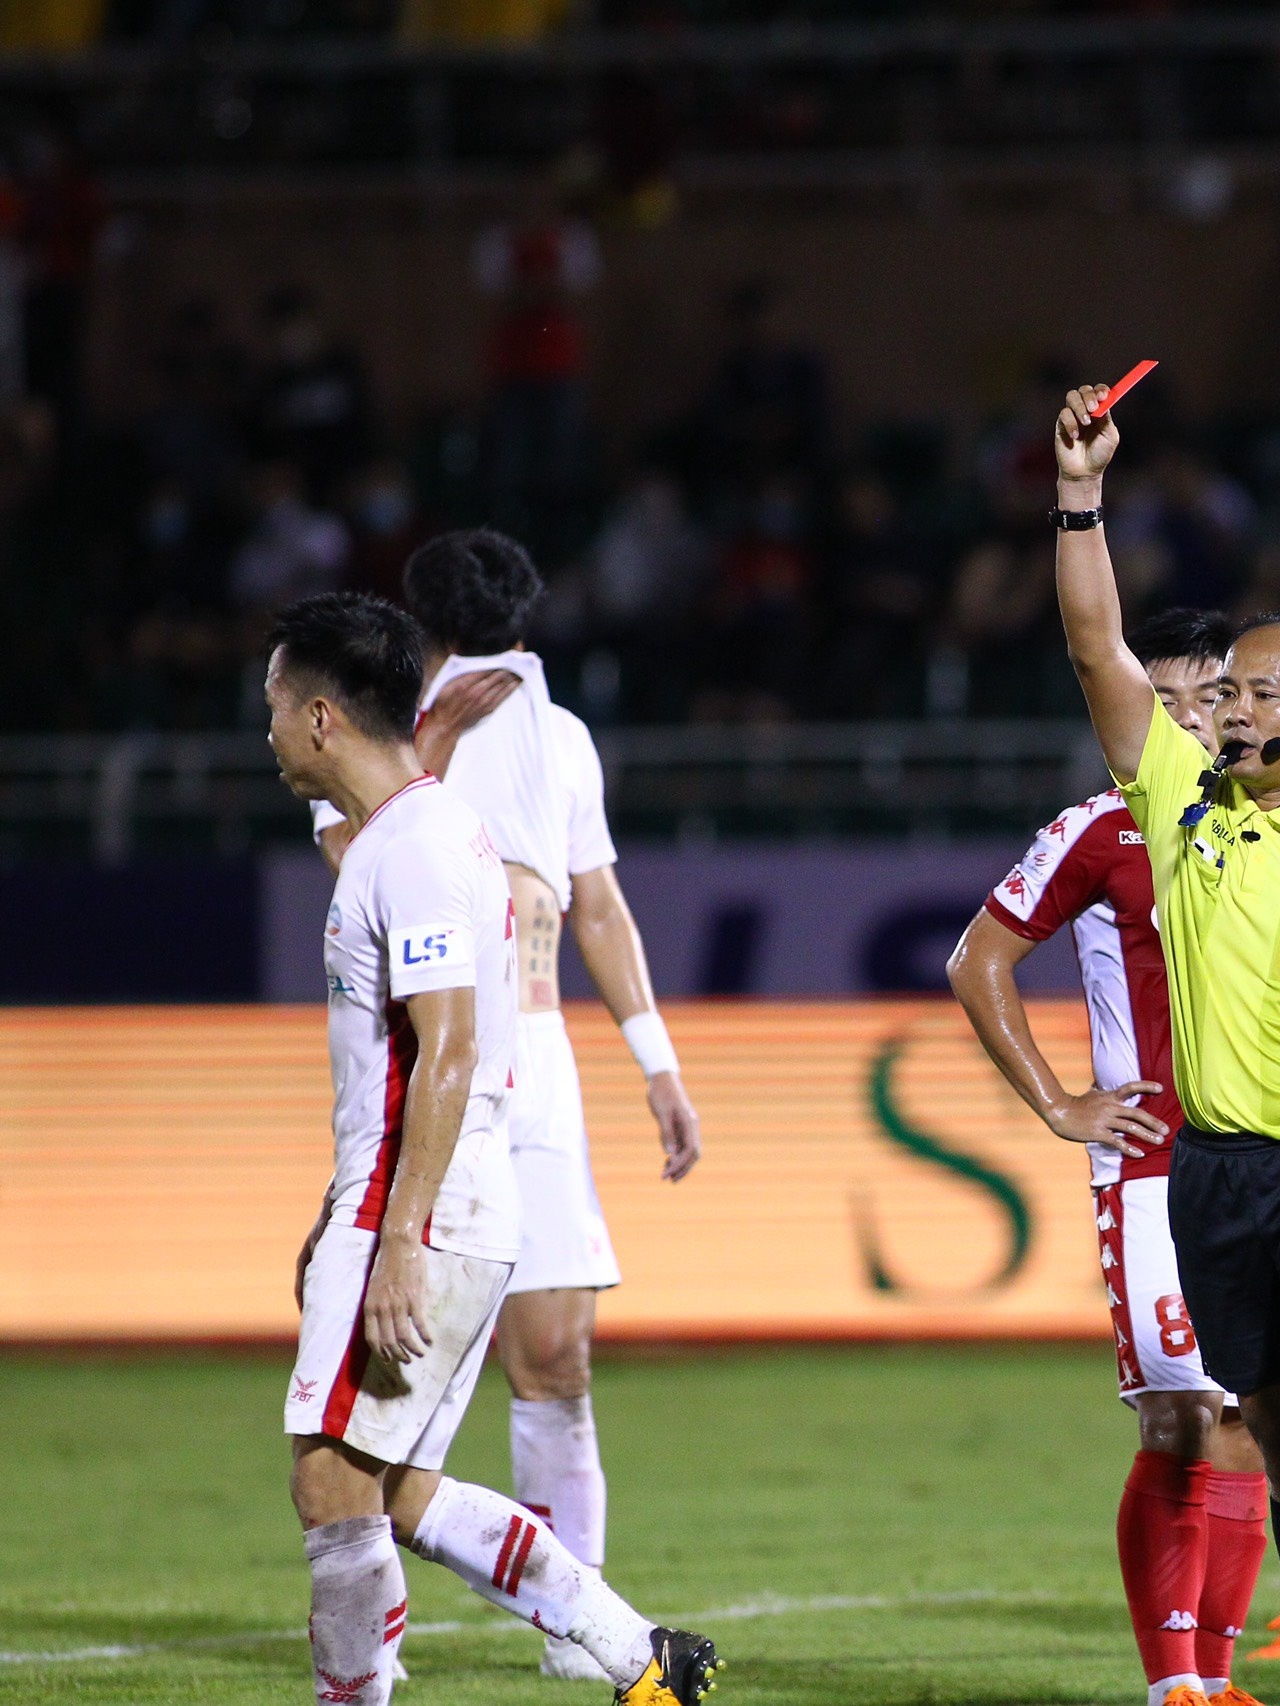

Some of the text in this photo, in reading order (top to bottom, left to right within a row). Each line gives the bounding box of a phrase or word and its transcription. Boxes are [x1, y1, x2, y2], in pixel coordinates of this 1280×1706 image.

[403, 933, 448, 965] LS
[1154, 1292, 1197, 1358] 8
[291, 1390, 316, 1403] FBT
